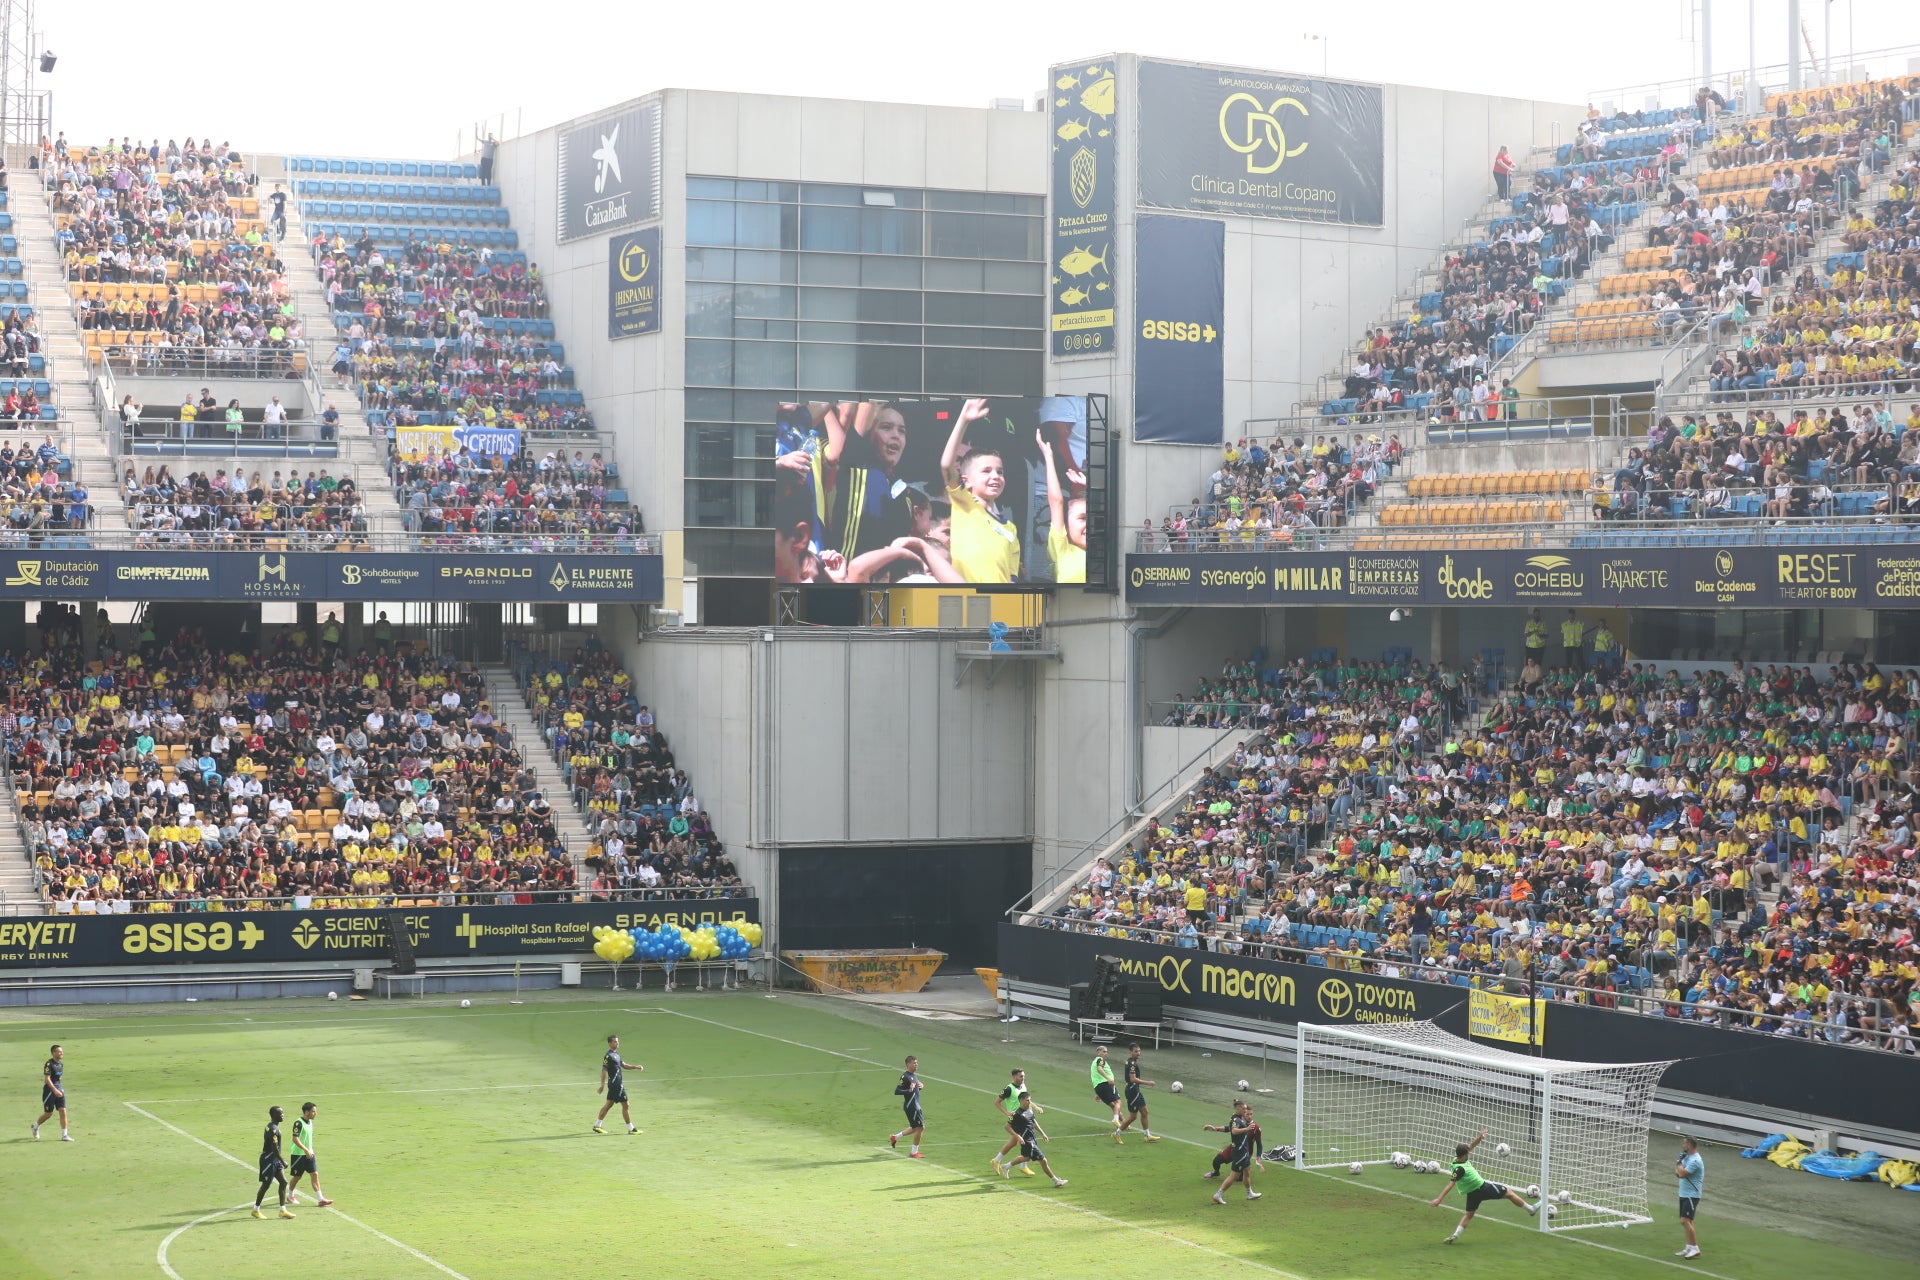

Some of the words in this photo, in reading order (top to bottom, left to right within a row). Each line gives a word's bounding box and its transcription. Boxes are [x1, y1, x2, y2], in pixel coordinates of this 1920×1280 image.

[1218, 76, 1274, 91] IMPLANTOLOGÍA
[1275, 83, 1311, 94] AVANZADA
[1191, 175, 1235, 195] Clínica
[1238, 179, 1282, 198] Dental
[1285, 183, 1336, 205] Copano
[585, 197, 627, 227] CaixaBank
[616, 286, 652, 306] HISPANIA
[1059, 315, 1106, 328] petacachico.com
[1142, 319, 1201, 343] asisa
[45, 560, 99, 573] Diputación
[1357, 556, 1419, 569] CONFEDERACIÓN
[1778, 553, 1856, 584] RESET
[131, 566, 209, 579] IMPREZIONA
[362, 568, 419, 579] SohoBoutique
[441, 567, 533, 578] SPAGNOLO
[572, 569, 585, 579] EL
[589, 569, 633, 579] PUENTE
[1145, 567, 1191, 581] SERRANO
[1291, 567, 1342, 591] MILAR
[1357, 571, 1419, 582] EMPRESAS
[1883, 572, 1894, 582] de
[45, 575, 58, 586] de
[61, 575, 89, 586] Cádiz
[572, 580, 615, 589] FARMACIA
[616, 580, 634, 589] 24H
[1514, 572, 1584, 588] COHEBU
[1717, 580, 1756, 593] Cadenas
[244, 583, 300, 591] HOSMAN
[1357, 586, 1389, 595] PROVINCIA
[1390, 586, 1398, 595] DE
[1399, 583, 1419, 595] CÁDIZ
[1779, 587, 1796, 599] THE
[1797, 587, 1815, 599] ART
[1815, 587, 1829, 599] OF
[1830, 587, 1857, 599] BODY
[1717, 594, 1735, 602] CASH
[325, 915, 430, 931] SCIENFIC
[484, 923, 528, 937] Hospital
[530, 922, 553, 935] San
[555, 921, 590, 934] Rafael
[0, 921, 76, 950] ERYETI
[123, 921, 233, 953] asisa
[521, 935, 555, 945] Hospitales
[556, 935, 584, 944] Pascual
[29, 952, 69, 960] DRINK
[1202, 963, 1296, 1007] macron
[1355, 982, 1416, 1012] TOYOTA
[1355, 1008, 1384, 1025] GAMO
